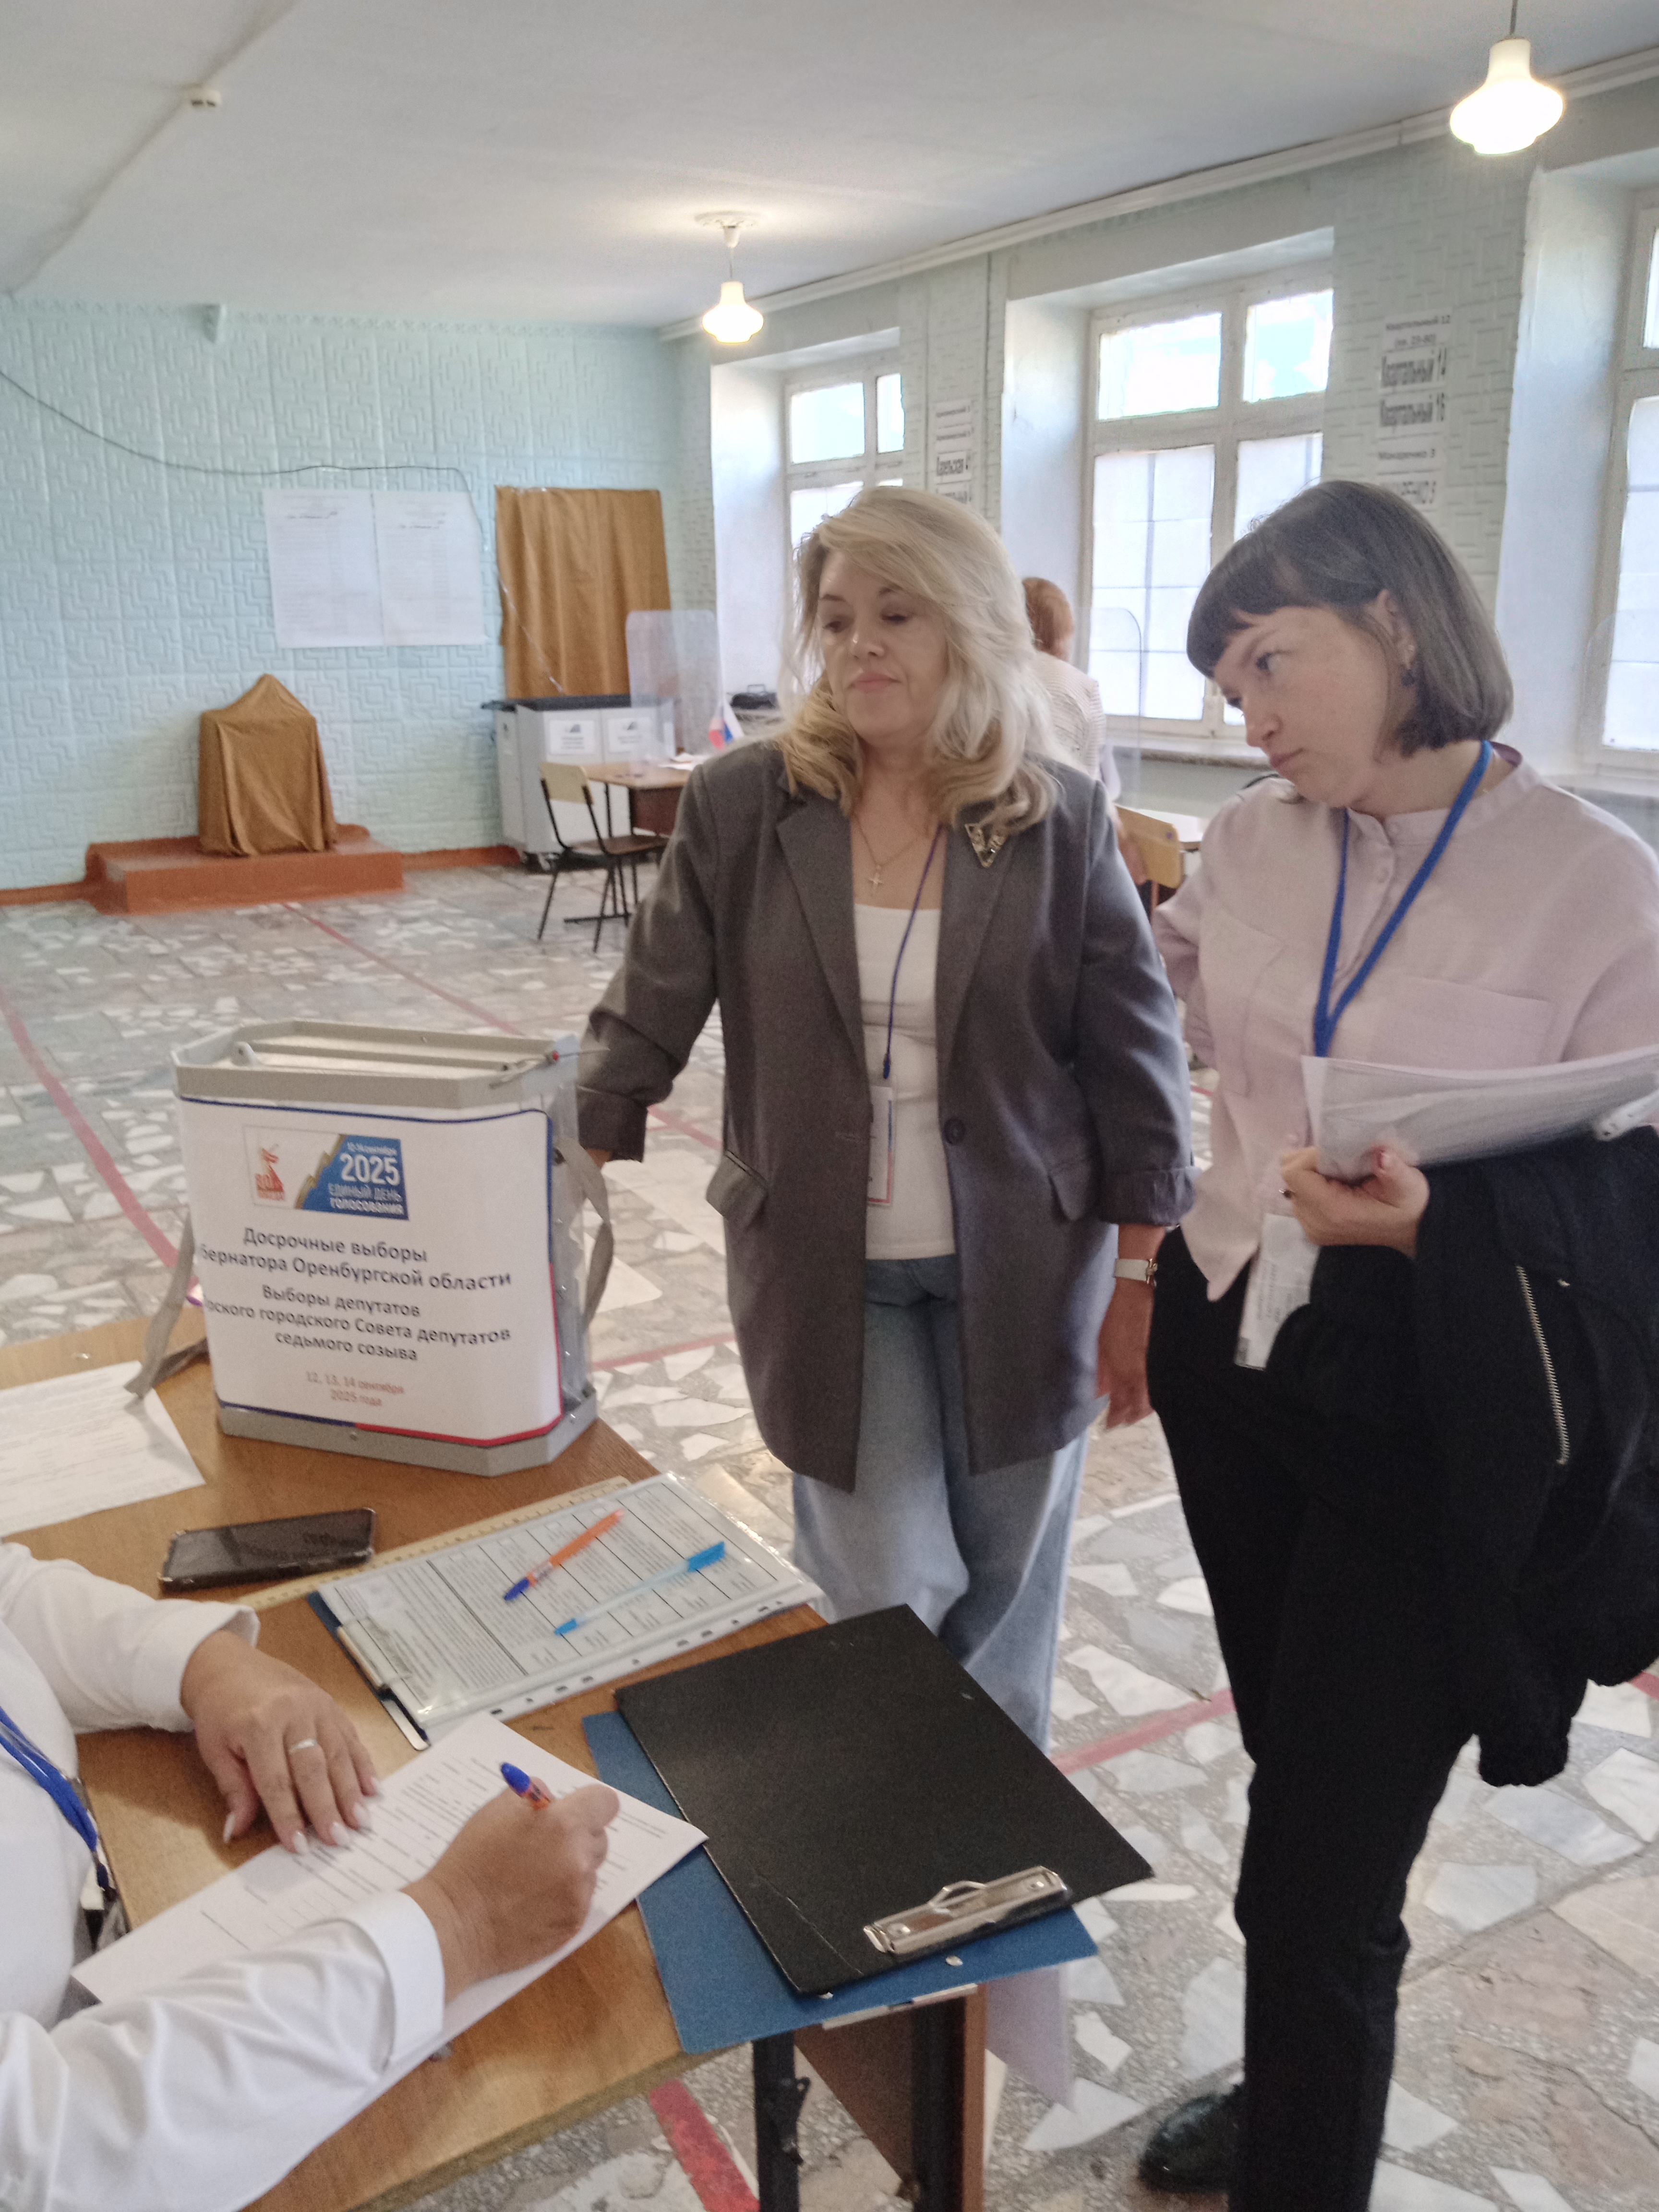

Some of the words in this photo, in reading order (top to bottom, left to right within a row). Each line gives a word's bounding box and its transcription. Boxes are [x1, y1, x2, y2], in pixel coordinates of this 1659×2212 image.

[340, 1153, 401, 1187] 2025
[243, 1227, 345, 1254] Досрочные
[351, 1241, 427, 1264] выборы
[199, 1243, 288, 1273] бернатора
[292, 1257, 423, 1286] Оренбургской
[429, 1273, 511, 1290] области
[263, 1284, 330, 1308] Выборы
[335, 1296, 421, 1317] депутатов
[259, 1309, 350, 1331] городского
[355, 1318, 412, 1338] Совета
[417, 1329, 511, 1348] депутатов
[275, 1332, 353, 1353] седьмого
[358, 1343, 418, 1361] созыва
